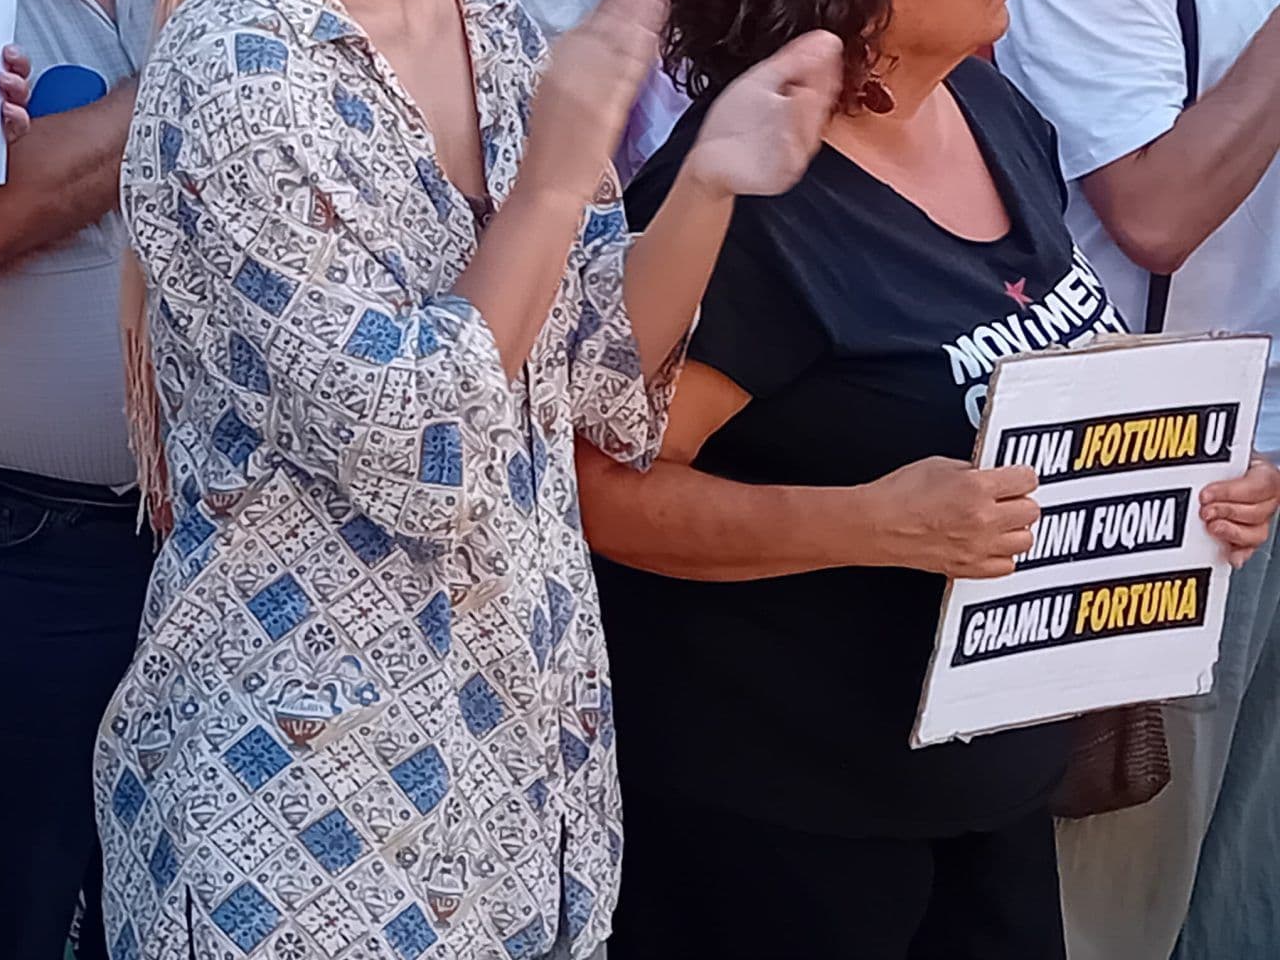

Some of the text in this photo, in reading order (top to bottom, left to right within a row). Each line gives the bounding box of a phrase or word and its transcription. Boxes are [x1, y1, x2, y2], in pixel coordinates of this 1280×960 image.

[1073, 414, 1198, 471] JFOTTUNA
[1204, 411, 1227, 456] U
[1087, 497, 1176, 550] FUQNA
[1075, 578, 1197, 635] FORTUNA
